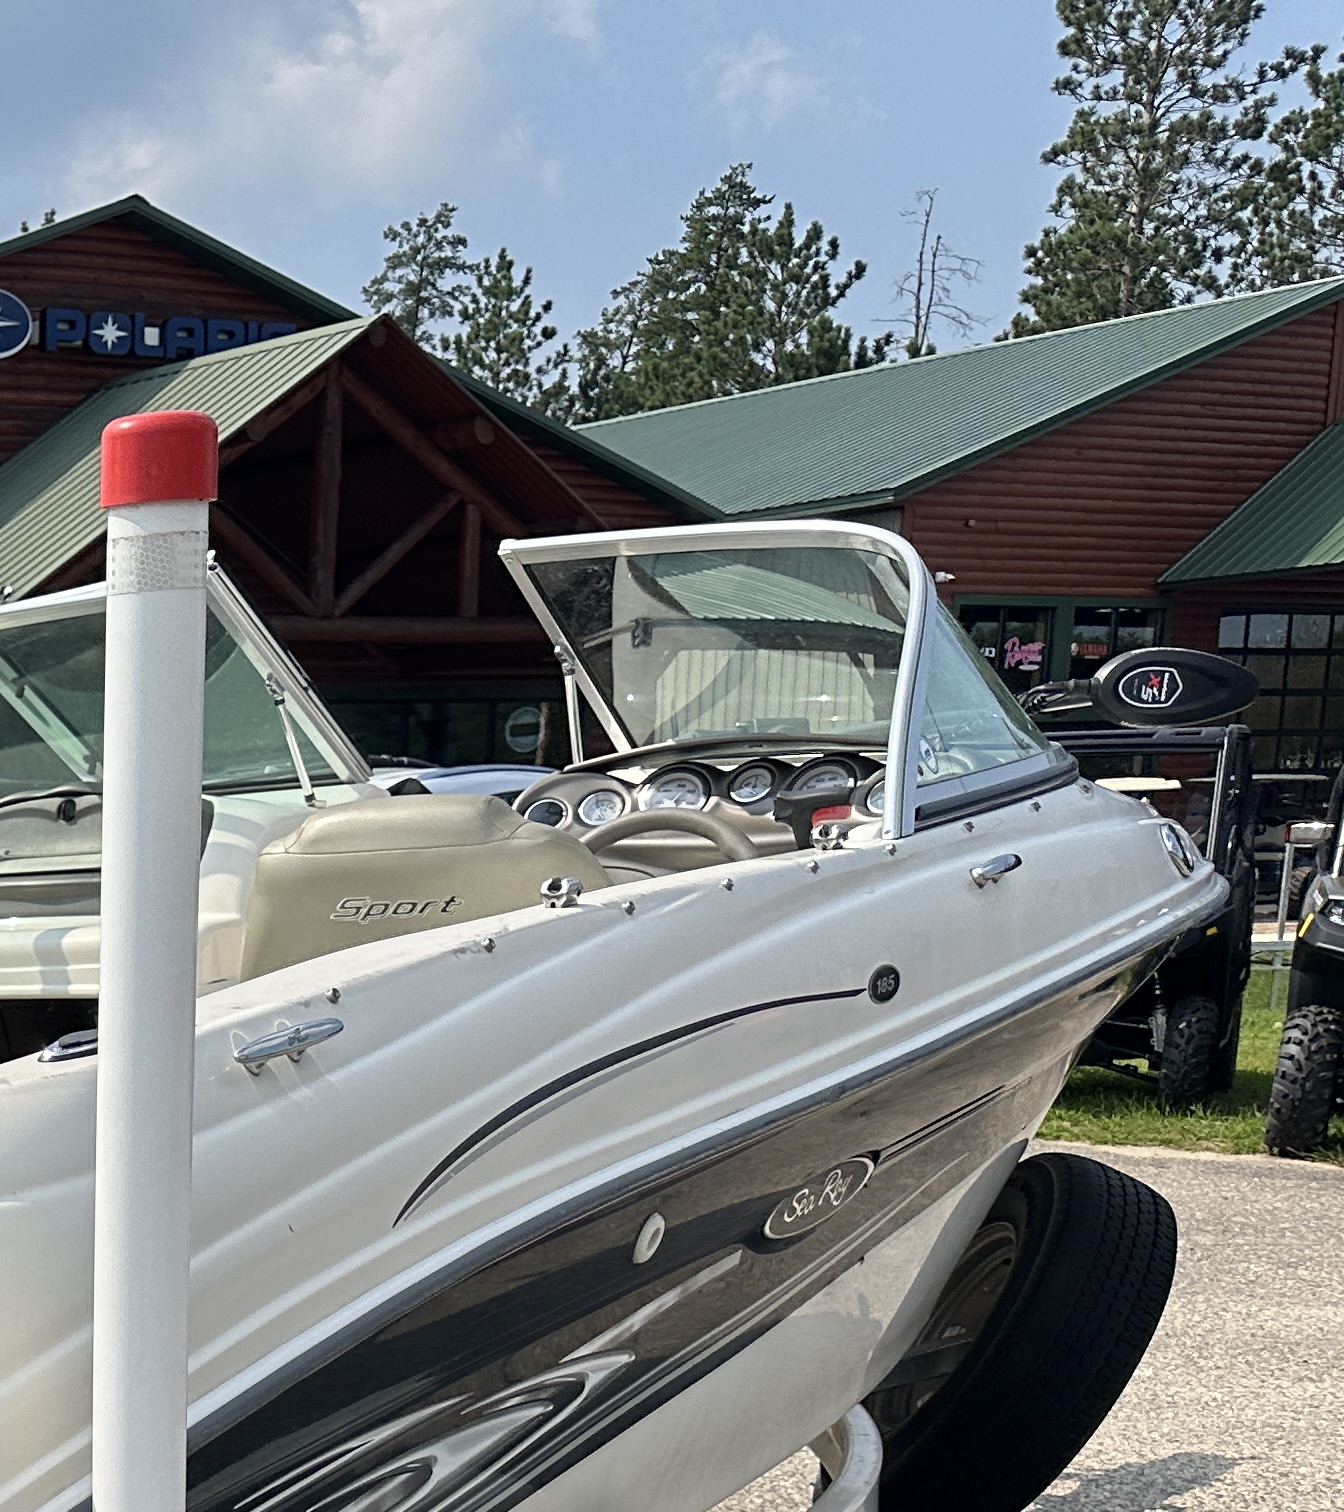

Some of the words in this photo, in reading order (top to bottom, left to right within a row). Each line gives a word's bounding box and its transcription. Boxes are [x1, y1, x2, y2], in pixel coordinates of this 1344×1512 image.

[330, 894, 464, 925] Sport
[783, 1188, 815, 1223] Sea
[818, 1168, 853, 1206] Ray
